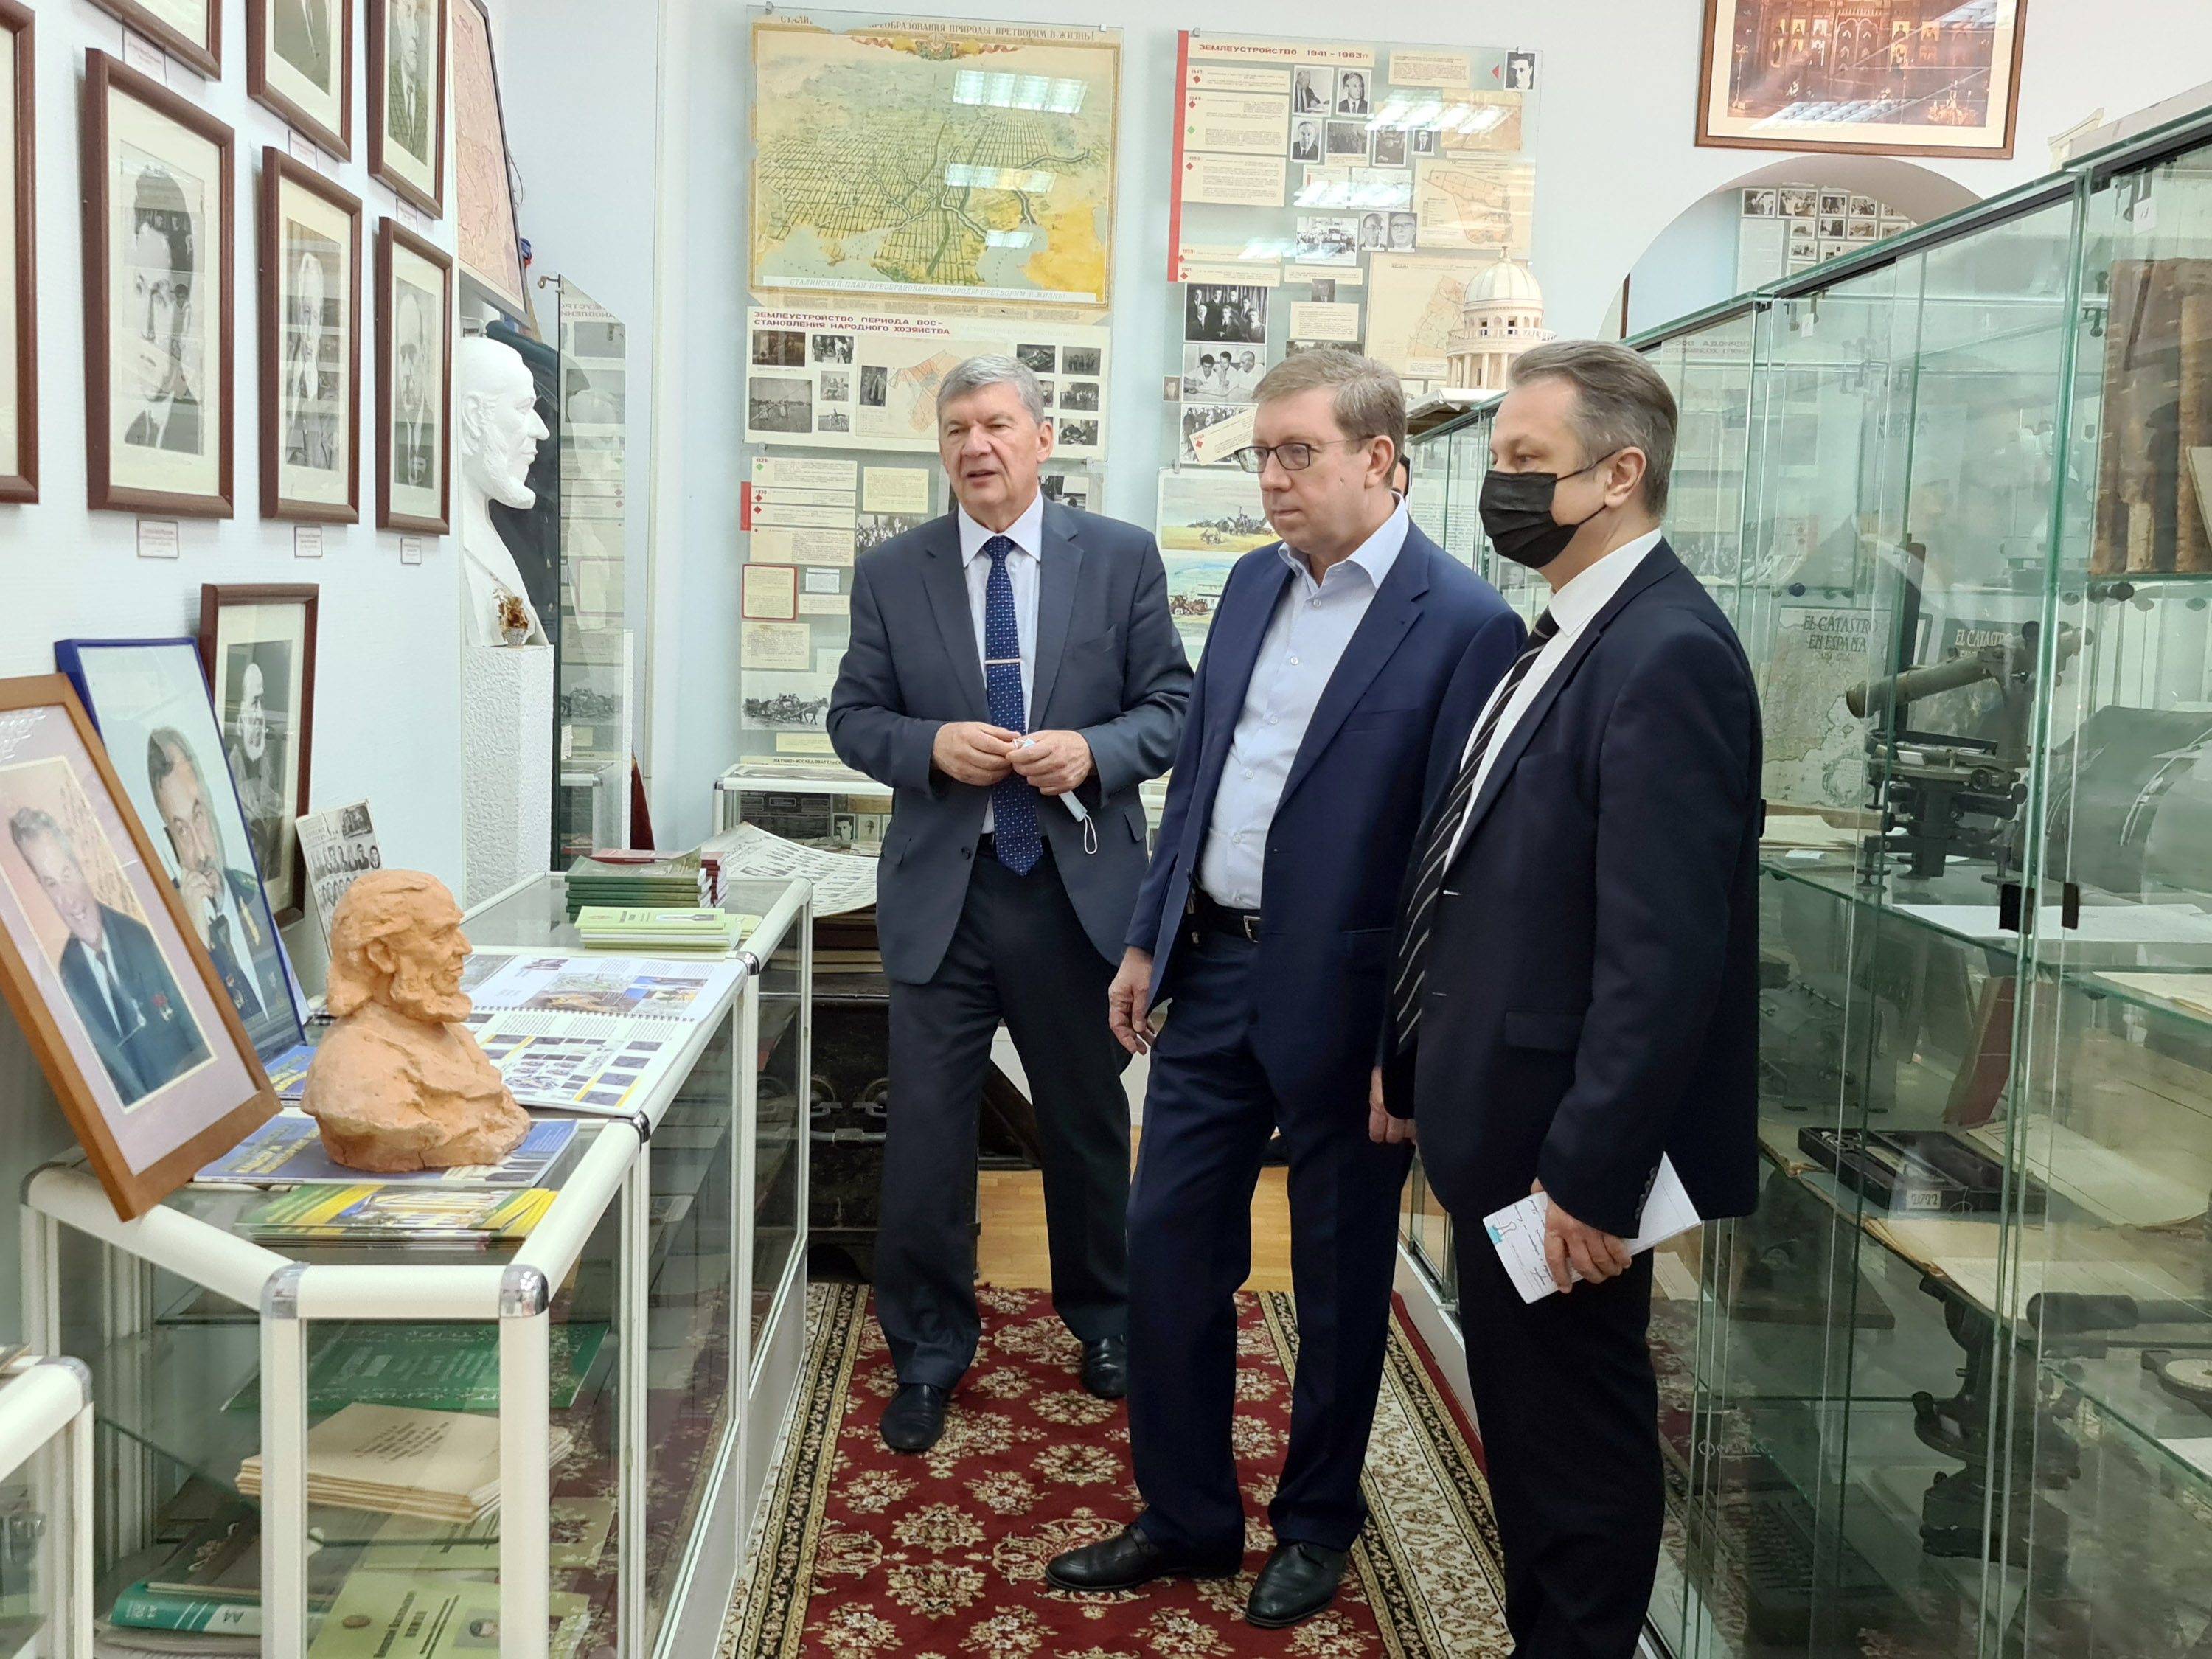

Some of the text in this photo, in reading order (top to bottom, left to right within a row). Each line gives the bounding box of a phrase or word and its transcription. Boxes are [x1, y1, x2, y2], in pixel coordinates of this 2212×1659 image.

[949, 24, 991, 35] ПРИРОДЫ
[995, 27, 1047, 38] ПРЕТВОРИМ
[1059, 31, 1094, 41] ЖИЗНЬ!
[1199, 44, 1298, 55] ЗЕМЛЕУСТРОЙСТВО
[790, 278, 842, 288] СТАЛИНСКИЙ
[844, 281, 866, 289] ПЛАН
[869, 282, 940, 293] ПРЕОБРАЗОВАНИЯ
[941, 286, 978, 295] ПРИРОДЫ
[754, 311, 854, 322] ЗЕМЛЕУСТРОЙСТВО
[860, 317, 910, 325] ПЕРИОДА
[754, 319, 826, 328] СТАНОВЛЕНИЯ
[830, 323, 889, 332] НАРОДНОГО
[894, 326, 950, 335] ХОЗЯЙСТВА
[1803, 616, 1877, 635] EL CATASTRO
[1809, 634, 1866, 653] EN ESPAÑA
[1955, 629, 1965, 646] EL
